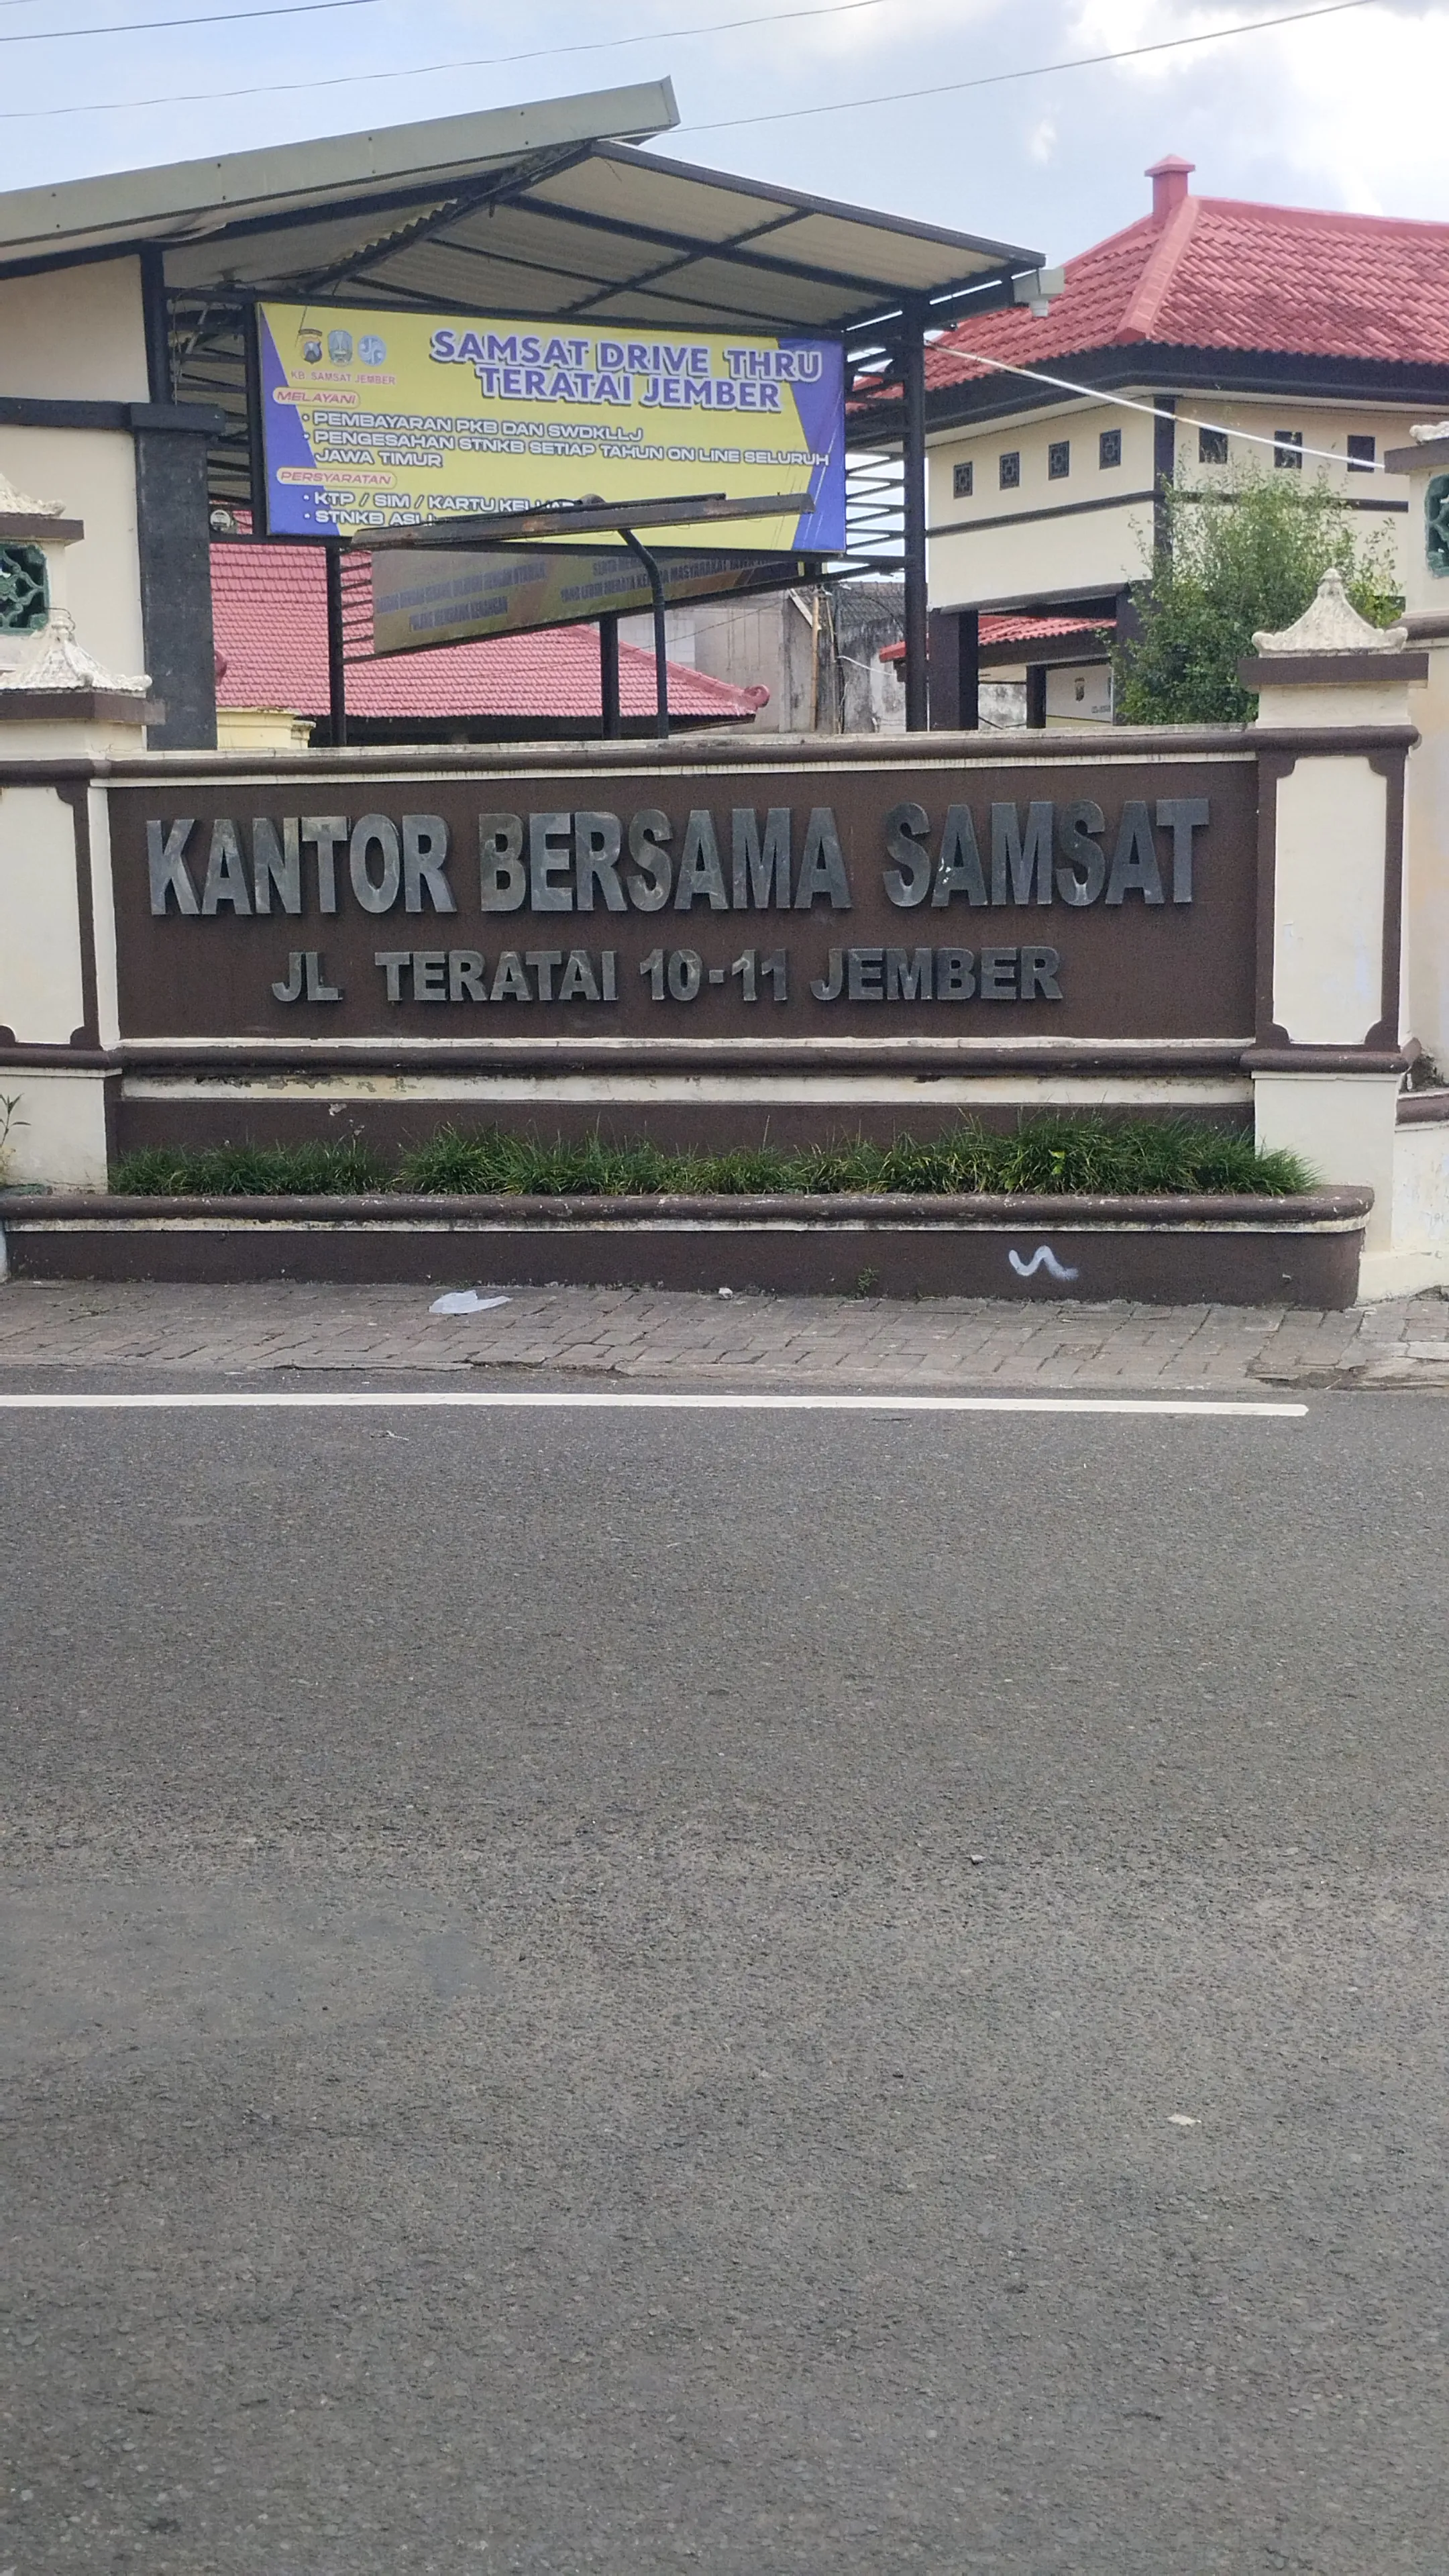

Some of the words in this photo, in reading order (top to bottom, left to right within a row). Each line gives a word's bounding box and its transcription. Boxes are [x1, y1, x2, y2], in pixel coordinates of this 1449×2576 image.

[433, 329, 590, 369] SAMSAT
[600, 341, 710, 374] DRIVE
[727, 350, 822, 381] THRU
[291, 370, 305, 380] KB
[311, 372, 352, 382] SAMSAT
[355, 374, 396, 384] JEMBER
[478, 367, 632, 402] TERATAI
[644, 377, 780, 409] JEMBER
[277, 391, 357, 404] MELAYANI
[313, 412, 451, 431] PEMBAYARAN
[456, 418, 498, 433] PKB
[502, 421, 543, 436] DAN
[548, 425, 642, 441] SWDKLLJ
[314, 431, 454, 449] PENGESAHAN
[459, 437, 525, 453] STNKB
[530, 441, 595, 456] SETIAP
[601, 445, 664, 460] TAHUN
[667, 448, 696, 461] ON
[700, 449, 741, 462] LINE
[745, 450, 829, 466] SELURUH
[315, 450, 374, 465] JAWA
[378, 451, 443, 467] TIMUR
[280, 471, 392, 485] PERSYARATAN
[314, 491, 354, 506] KTP
[360, 493, 370, 507] /
[374, 494, 411, 508] SIM
[415, 495, 425, 508] /
[429, 495, 495, 511] KARTU
[315, 509, 385, 525] STNKB
[146, 813, 458, 916] KANTOR
[478, 807, 852, 913] BERSAMA
[882, 798, 1209, 908] SAMSAT
[271, 951, 343, 1003] JL
[374, 949, 619, 1003] TERATAI
[640, 947, 788, 1002] 10-11
[810, 946, 1063, 1002] JEMBER
